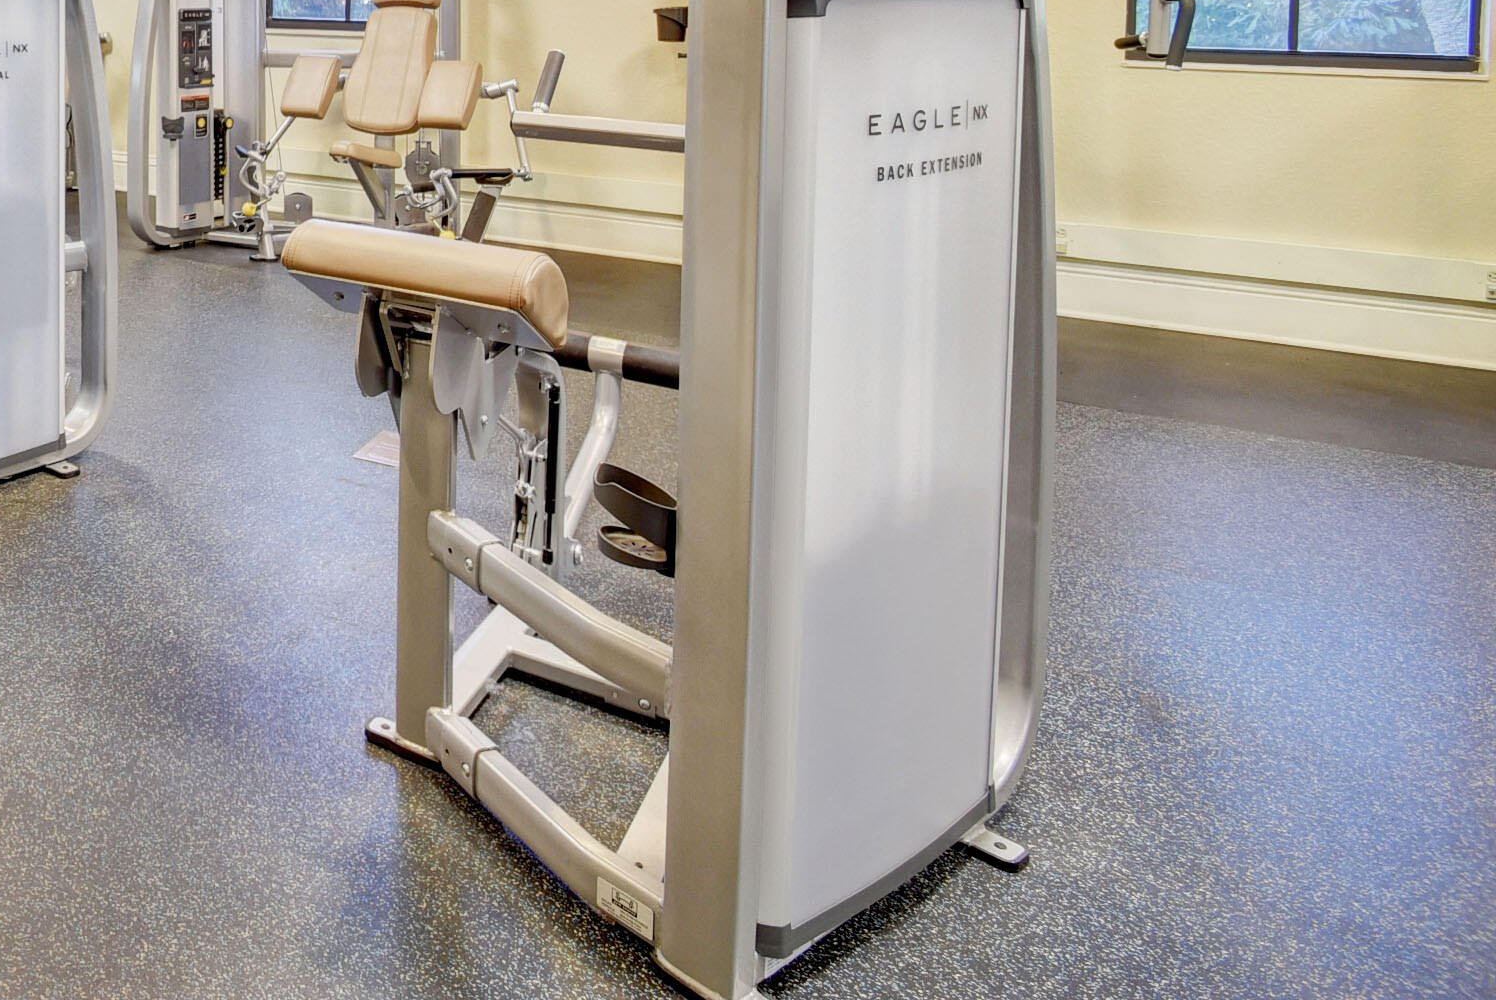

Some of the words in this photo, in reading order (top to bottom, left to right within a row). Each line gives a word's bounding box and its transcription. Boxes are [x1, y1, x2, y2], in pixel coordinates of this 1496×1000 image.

[12, 43, 29, 53] NX
[867, 105, 962, 136] EAGLE
[972, 104, 989, 121] NX
[877, 162, 914, 182] BACK
[920, 151, 983, 176] EXTENSION
